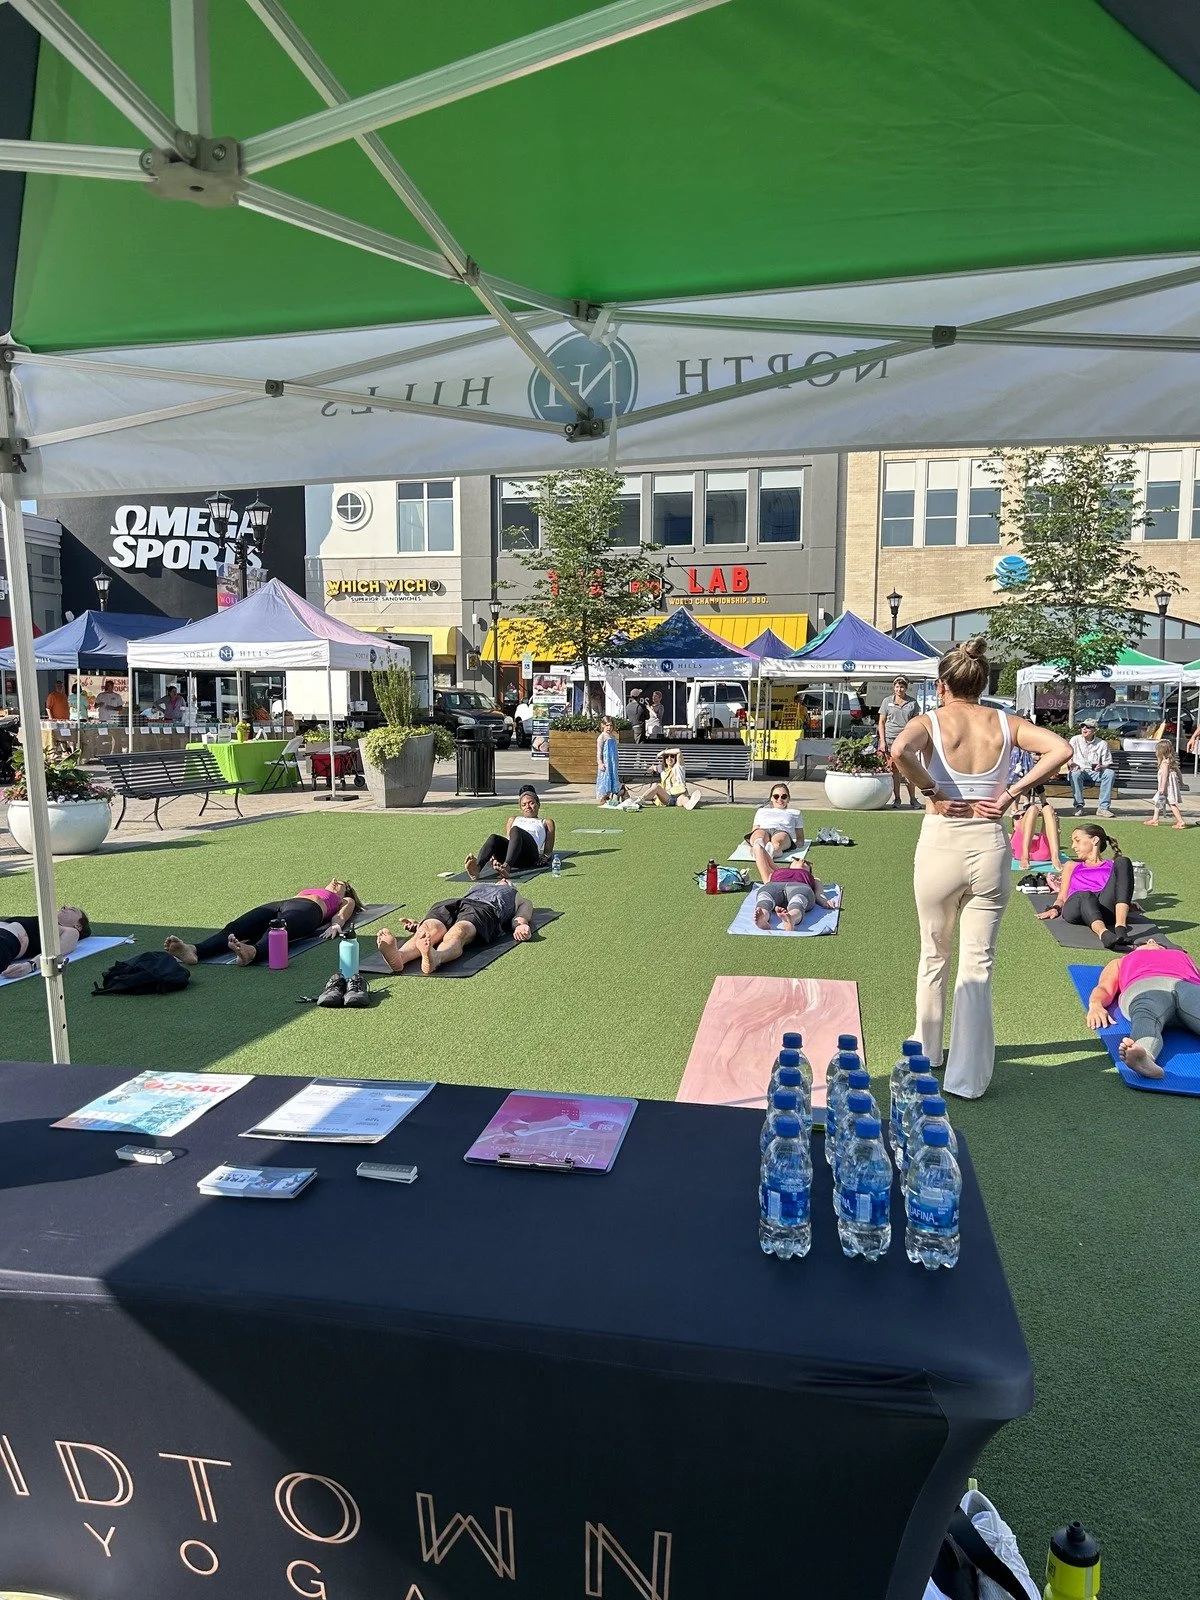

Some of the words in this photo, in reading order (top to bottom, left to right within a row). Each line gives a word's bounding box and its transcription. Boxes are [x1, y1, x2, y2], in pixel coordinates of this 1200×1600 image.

[327, 580, 380, 596] WHICH
[689, 567, 750, 594] LAB
[1048, 698, 1106, 708] 919-5-8429
